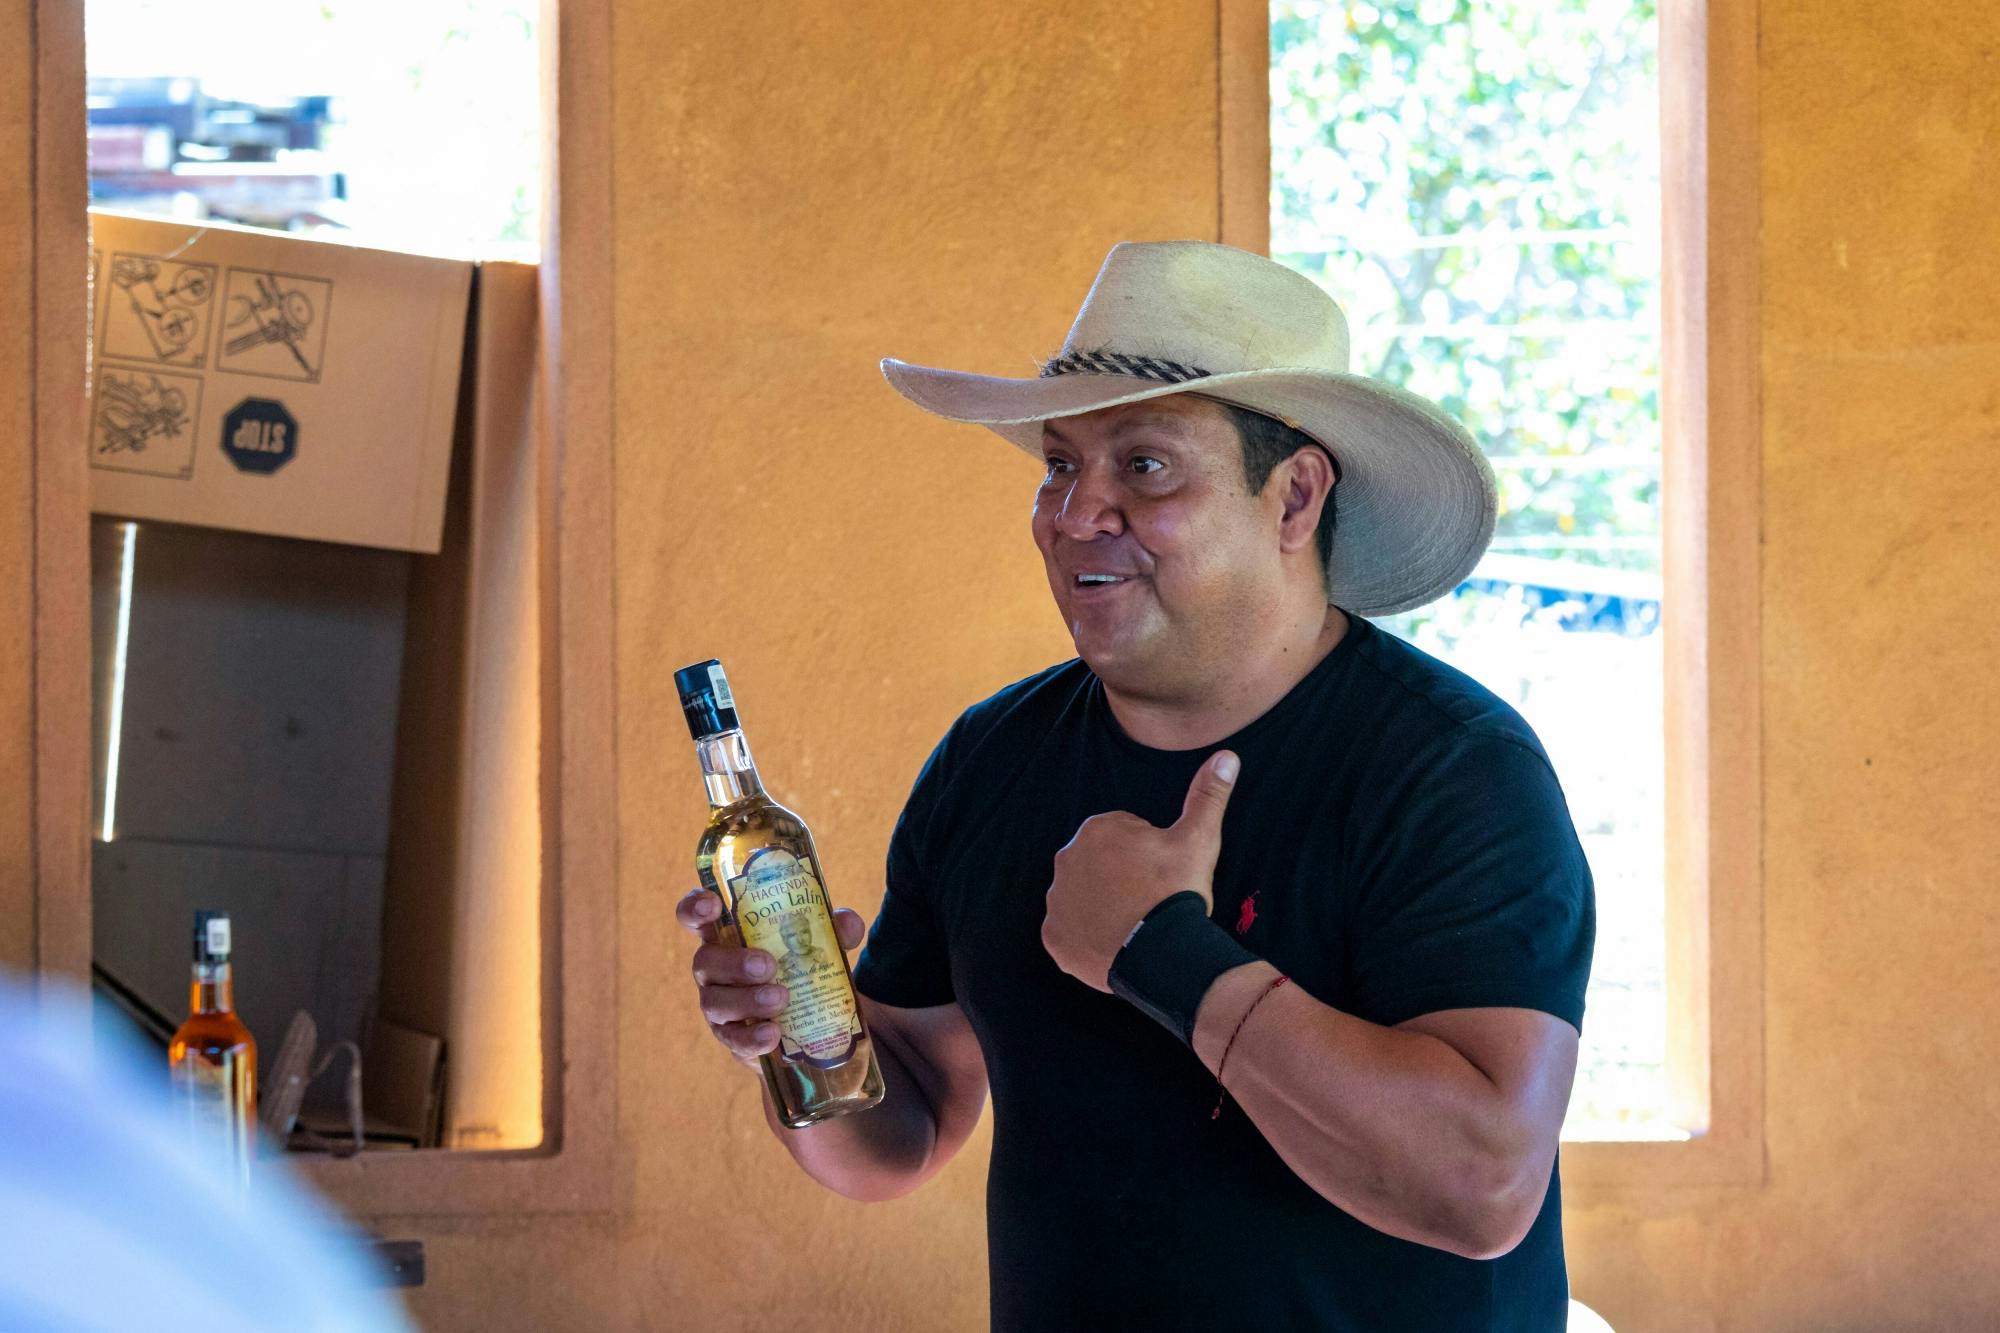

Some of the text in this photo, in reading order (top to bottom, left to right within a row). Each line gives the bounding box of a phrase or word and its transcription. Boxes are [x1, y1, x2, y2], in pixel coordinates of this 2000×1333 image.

[232, 419, 287, 454] STOP
[750, 876, 809, 903] HACIENDA
[744, 900, 783, 927] Don
[787, 1019, 815, 1032] Hecho
